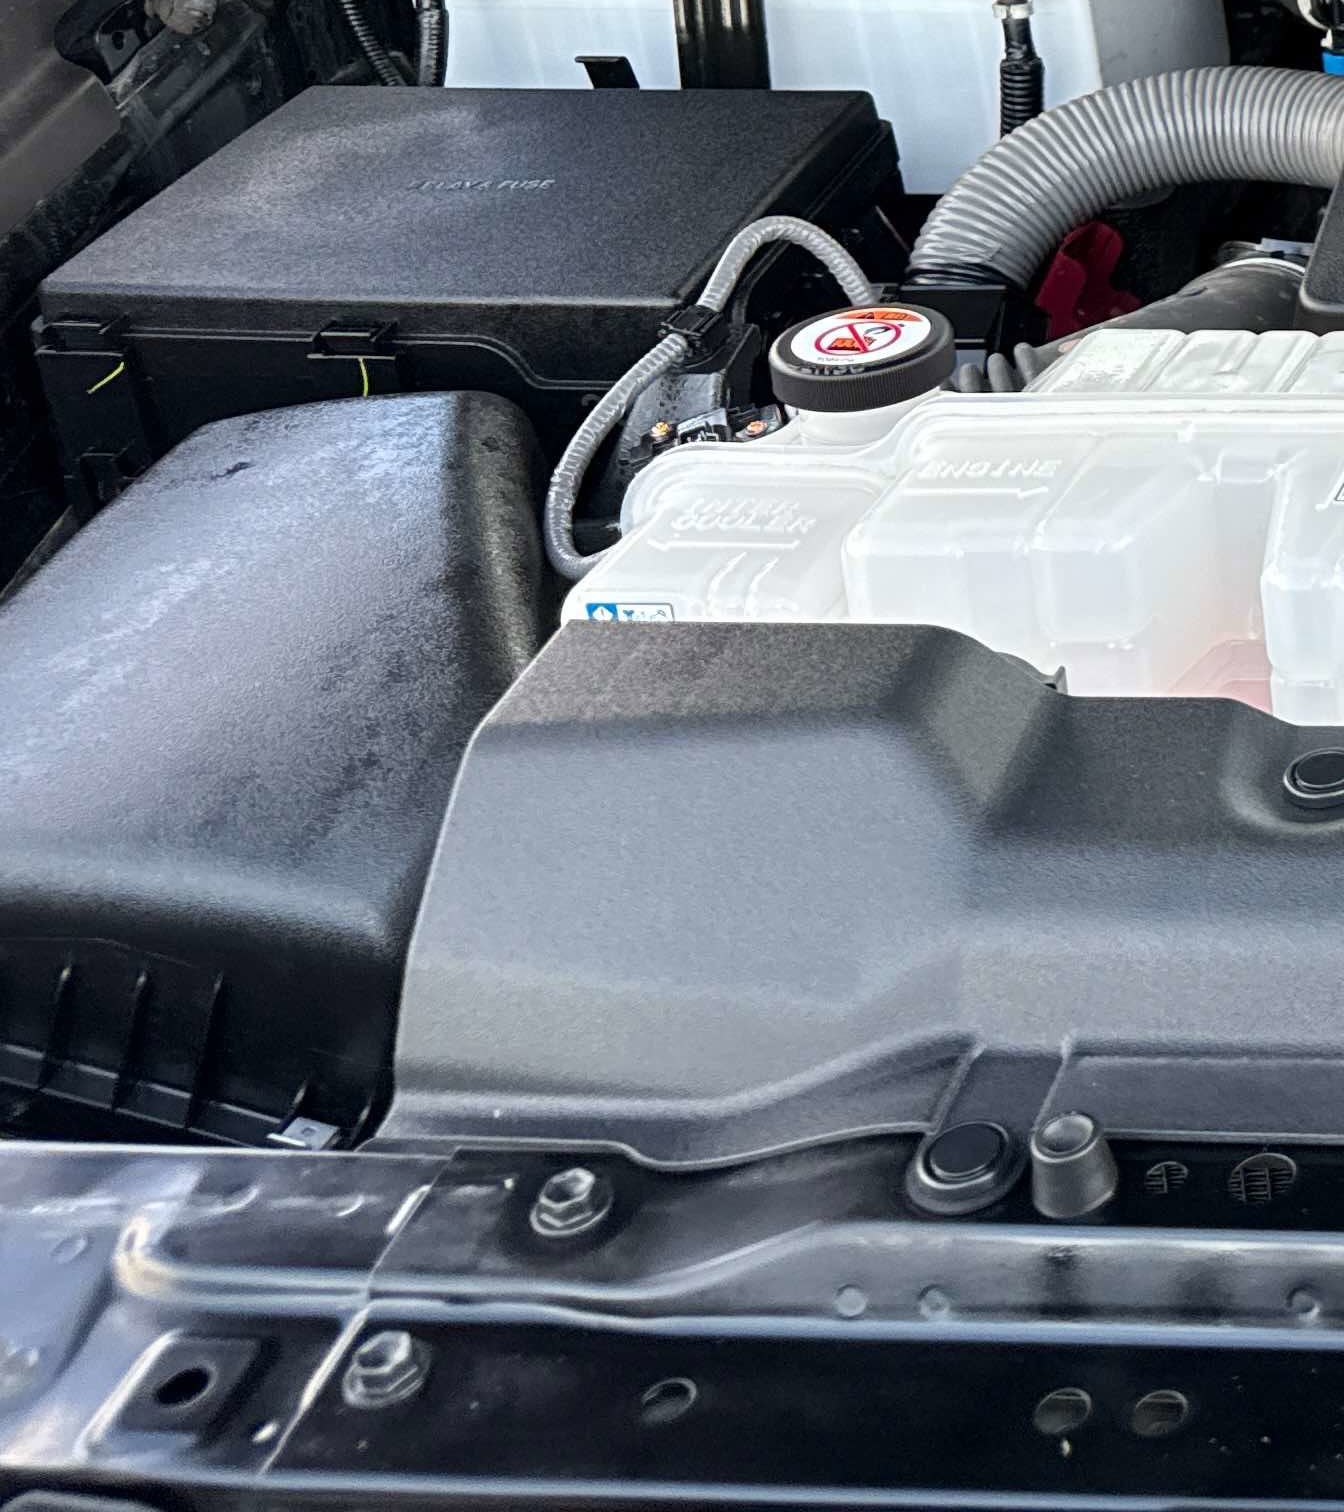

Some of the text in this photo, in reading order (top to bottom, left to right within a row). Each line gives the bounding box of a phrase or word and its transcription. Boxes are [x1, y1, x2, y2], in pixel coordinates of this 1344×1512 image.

[497, 178, 556, 191] FUSE
[916, 458, 1063, 480] ENGINE
[670, 512, 817, 534] COOLER
